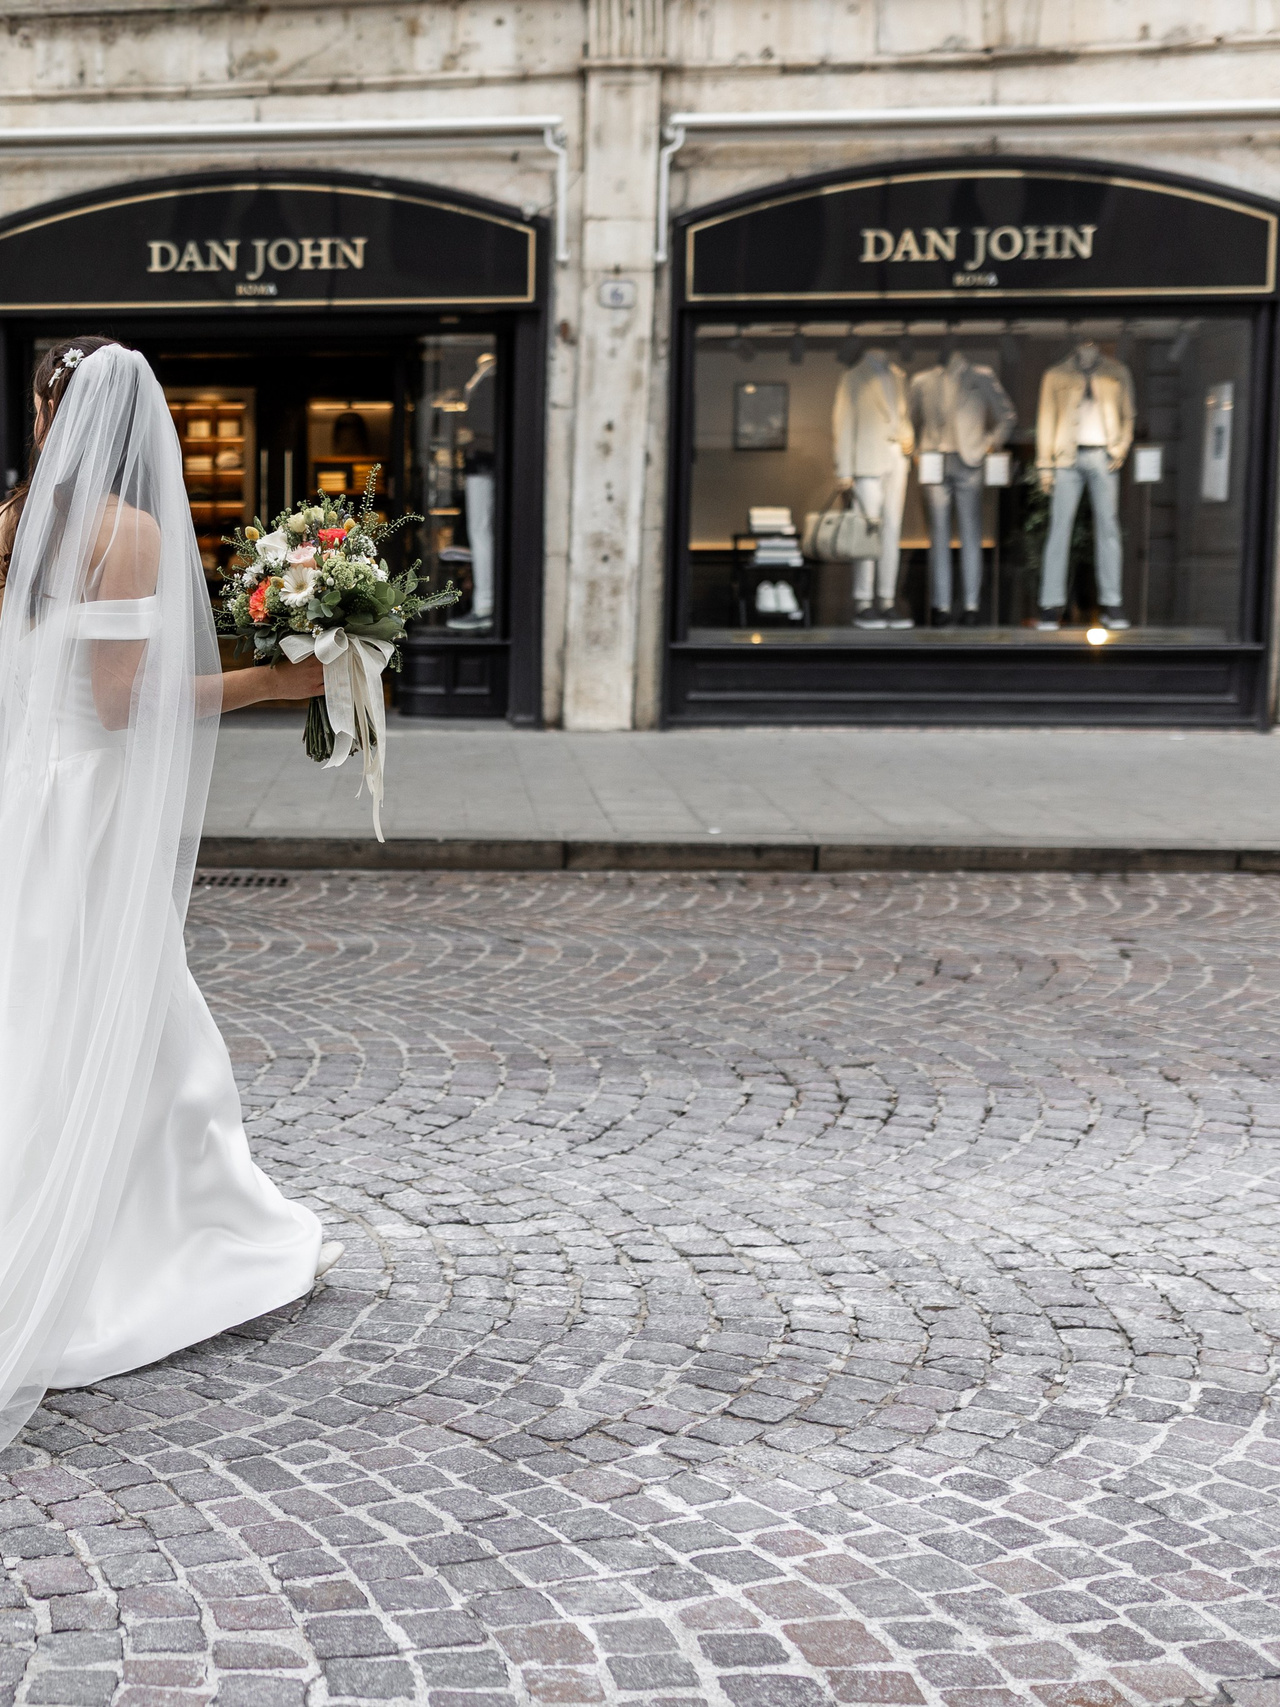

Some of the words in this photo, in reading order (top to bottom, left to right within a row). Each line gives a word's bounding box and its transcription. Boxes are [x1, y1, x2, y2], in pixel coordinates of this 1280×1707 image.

[147, 239, 240, 272] DAN
[246, 237, 368, 281] JOHN
[859, 227, 961, 263] DAN
[964, 224, 1098, 271] JOHN
